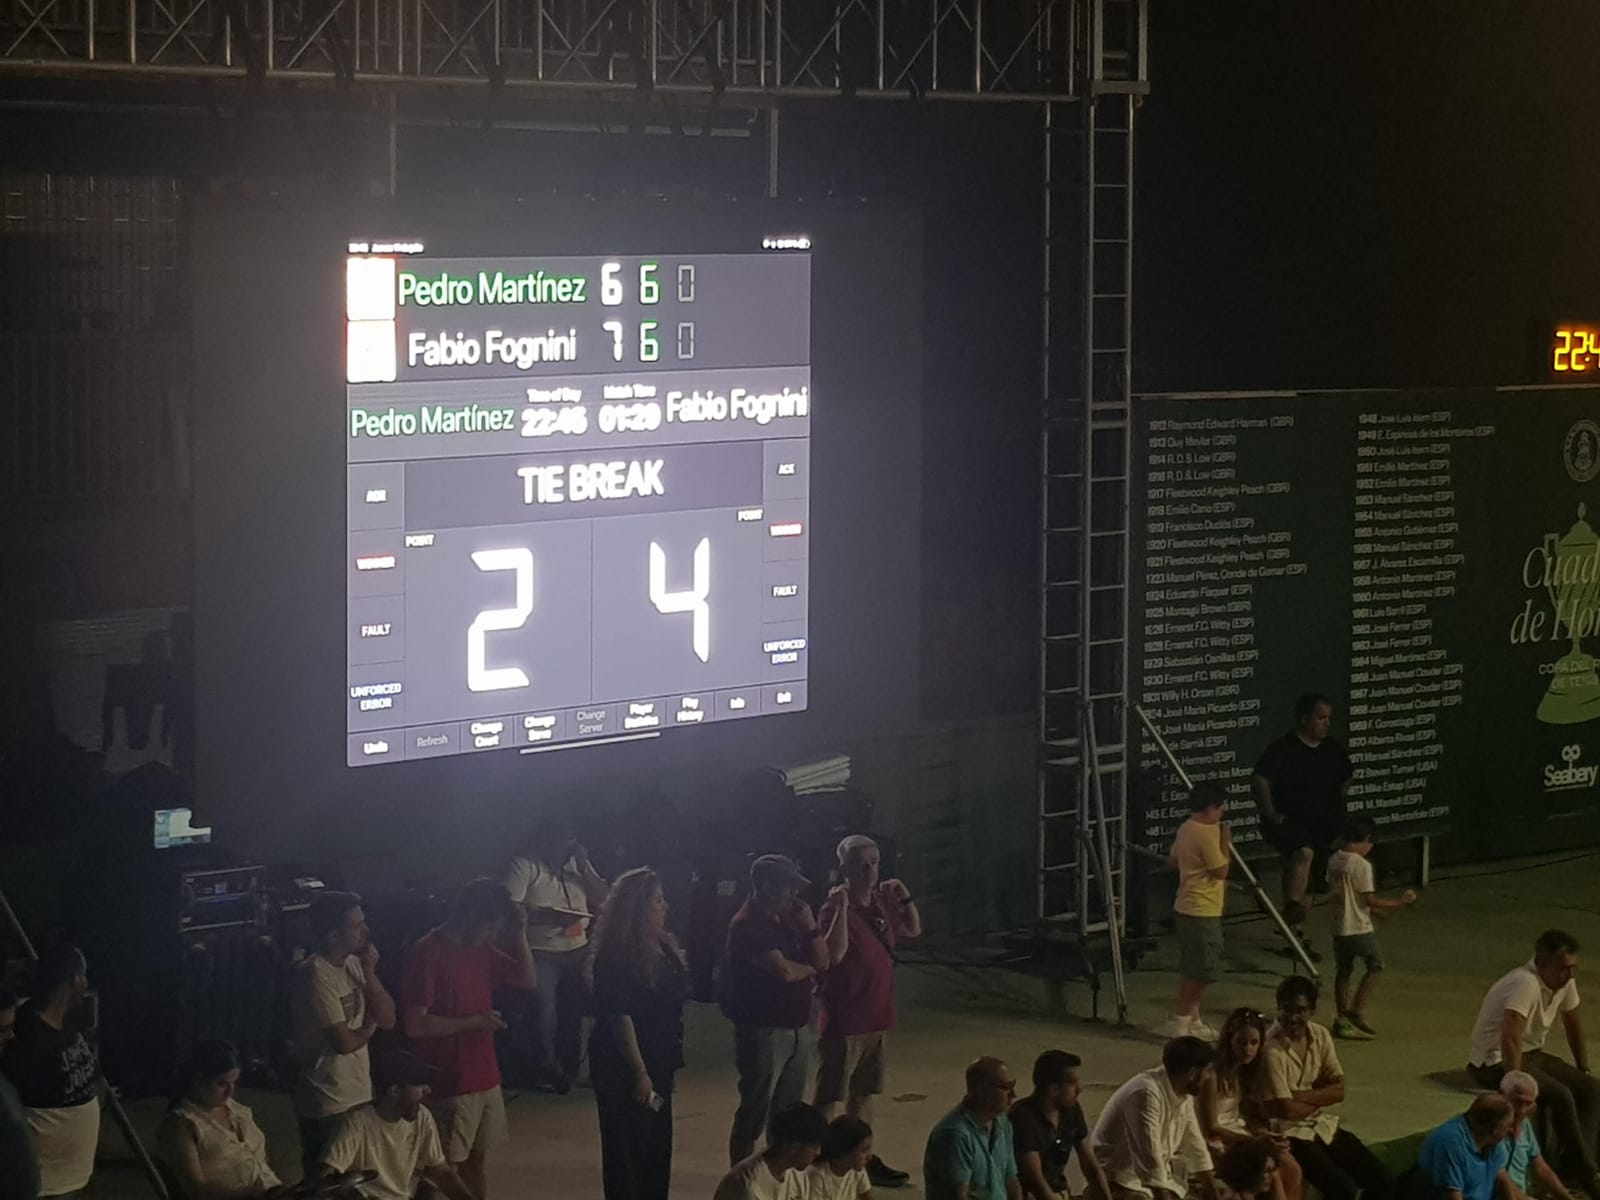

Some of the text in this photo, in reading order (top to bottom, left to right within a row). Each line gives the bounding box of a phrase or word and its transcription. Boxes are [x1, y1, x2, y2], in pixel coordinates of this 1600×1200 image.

[399, 263, 695, 306] Pedro Martínez 6 6 0
[408, 321, 695, 370] Fabio Fognini 7 6 0
[351, 404, 514, 438] Pedro Martínez
[666, 386, 808, 424] Fabio Fognini
[517, 459, 665, 504] TIE BREAK
[649, 536, 711, 663] 4
[772, 585, 798, 597] FAULT
[361, 623, 391, 637] FAULT
[466, 546, 534, 692] 2
[1510, 599, 1545, 644] de
[763, 638, 806, 653] UNFORCED
[350, 682, 402, 698] UNFORCED
[360, 697, 393, 710] ERROR
[576, 709, 606, 722] Change
[416, 735, 449, 747] Refresh
